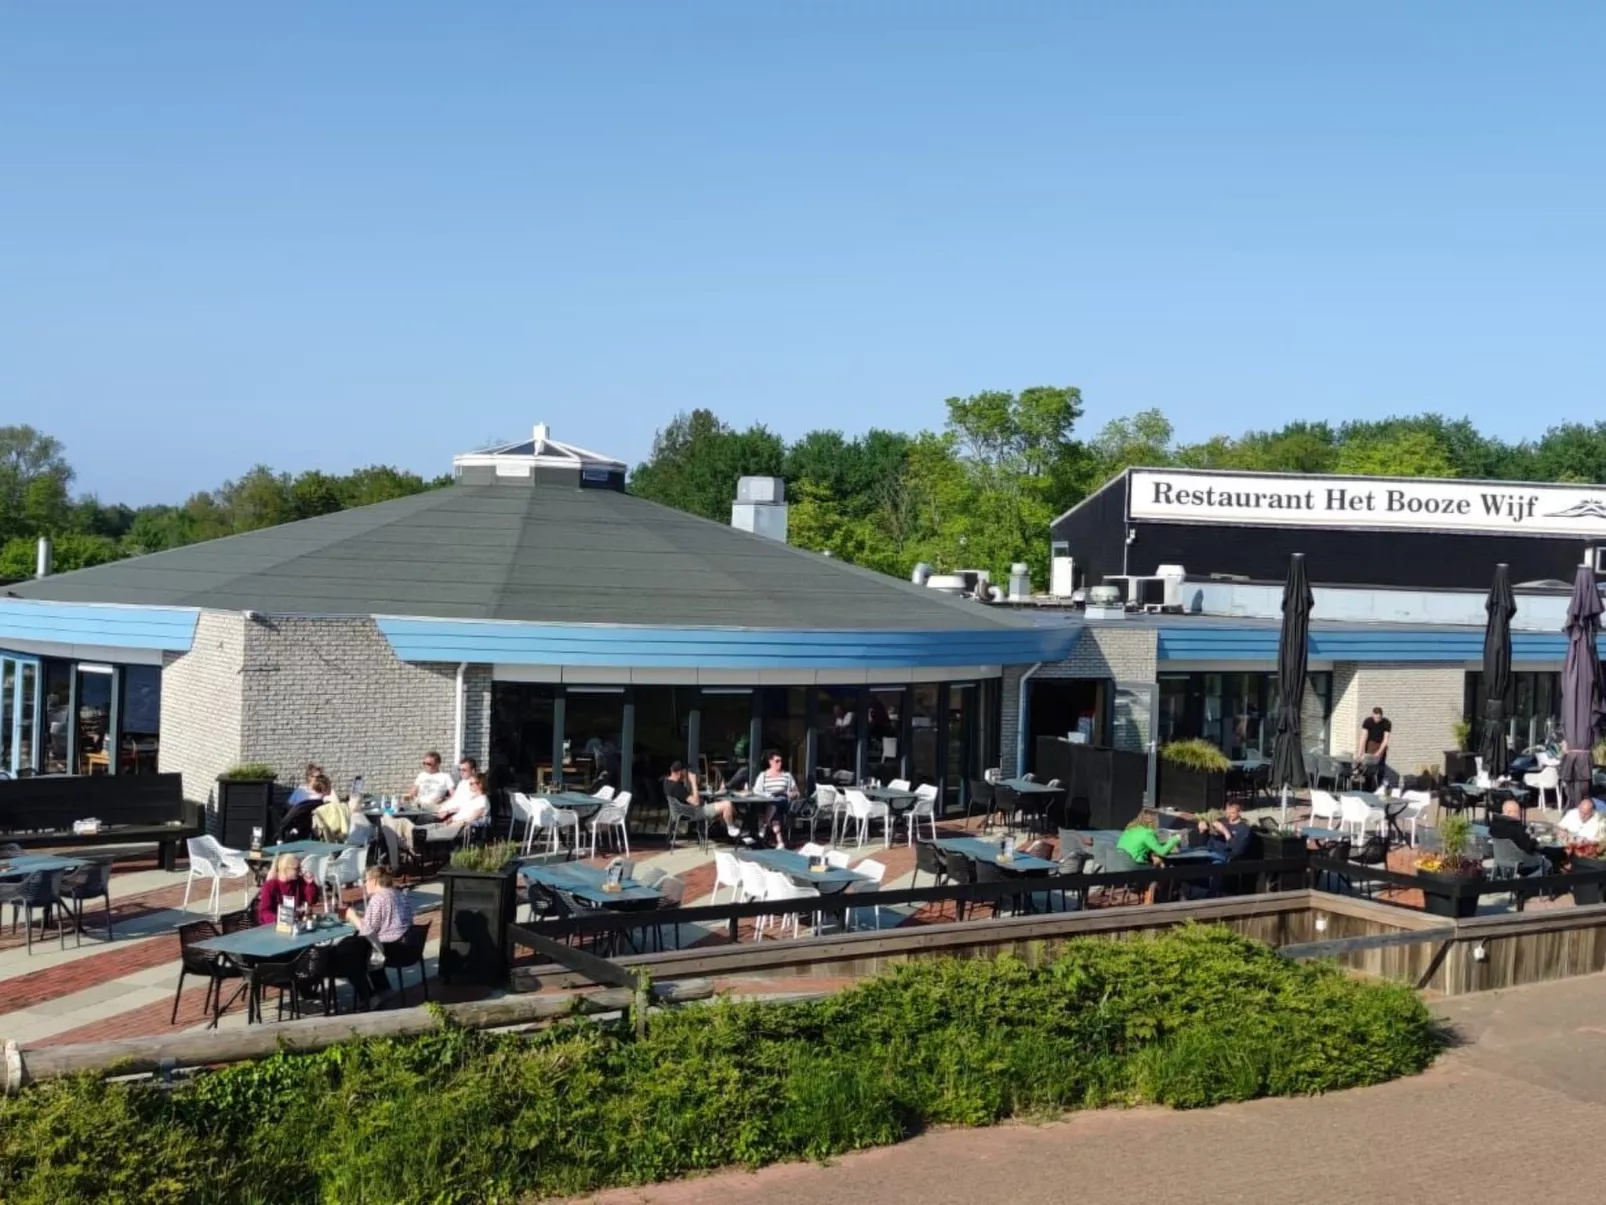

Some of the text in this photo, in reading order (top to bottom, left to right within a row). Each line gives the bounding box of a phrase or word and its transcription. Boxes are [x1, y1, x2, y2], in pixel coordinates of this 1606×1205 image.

[1152, 481, 1539, 521] Restaurant Het Booze Wijf
